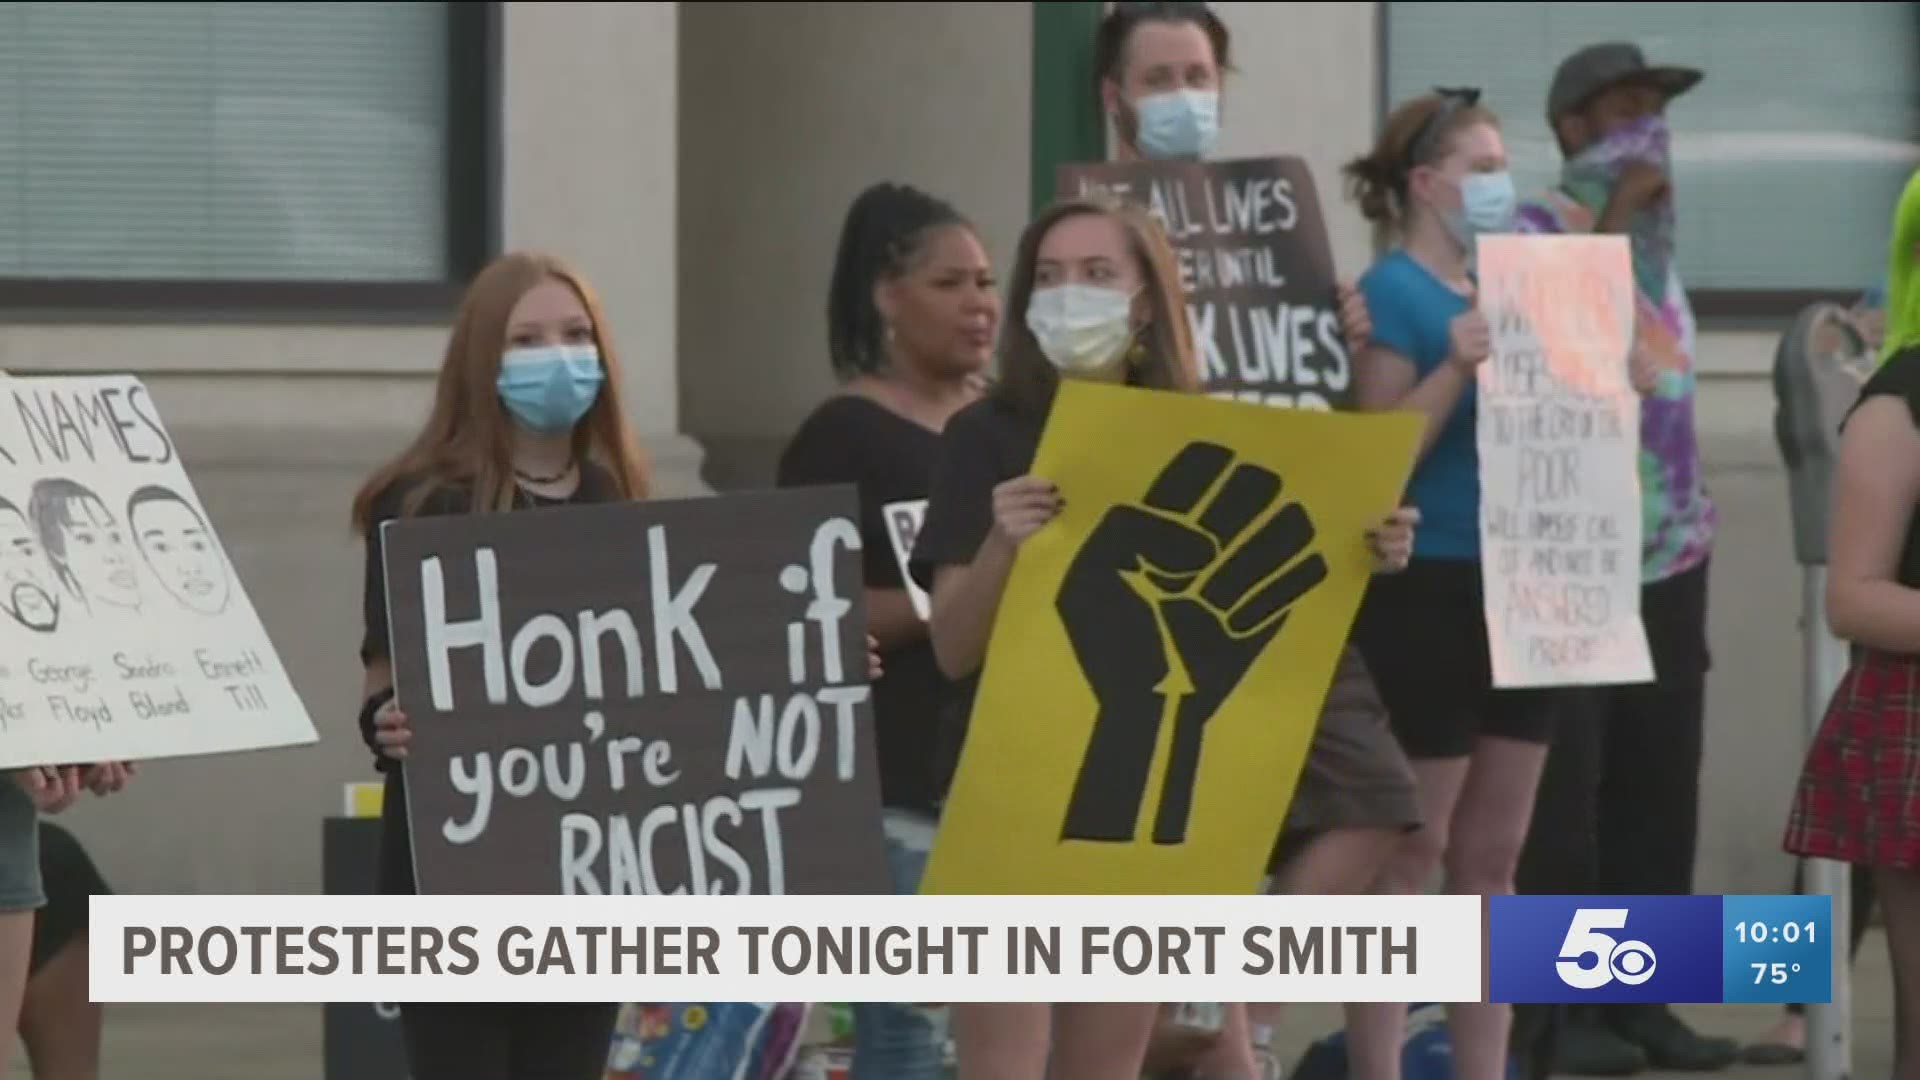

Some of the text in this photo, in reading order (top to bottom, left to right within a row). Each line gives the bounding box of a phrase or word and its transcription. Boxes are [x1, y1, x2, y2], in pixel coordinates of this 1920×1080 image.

[1149, 176, 1298, 238] ALL LIVES
[1215, 247, 1285, 289] UNTIL
[1228, 303, 1350, 392] LIVES
[13, 384, 172, 464] NAMES
[421, 517, 862, 712] Honk if
[28, 657, 93, 694] George
[47, 694, 113, 732] Floyd
[129, 684, 190, 720] Bland
[224, 684, 268, 712] Till
[442, 686, 871, 844] you're NOT
[560, 787, 802, 895] RACIST
